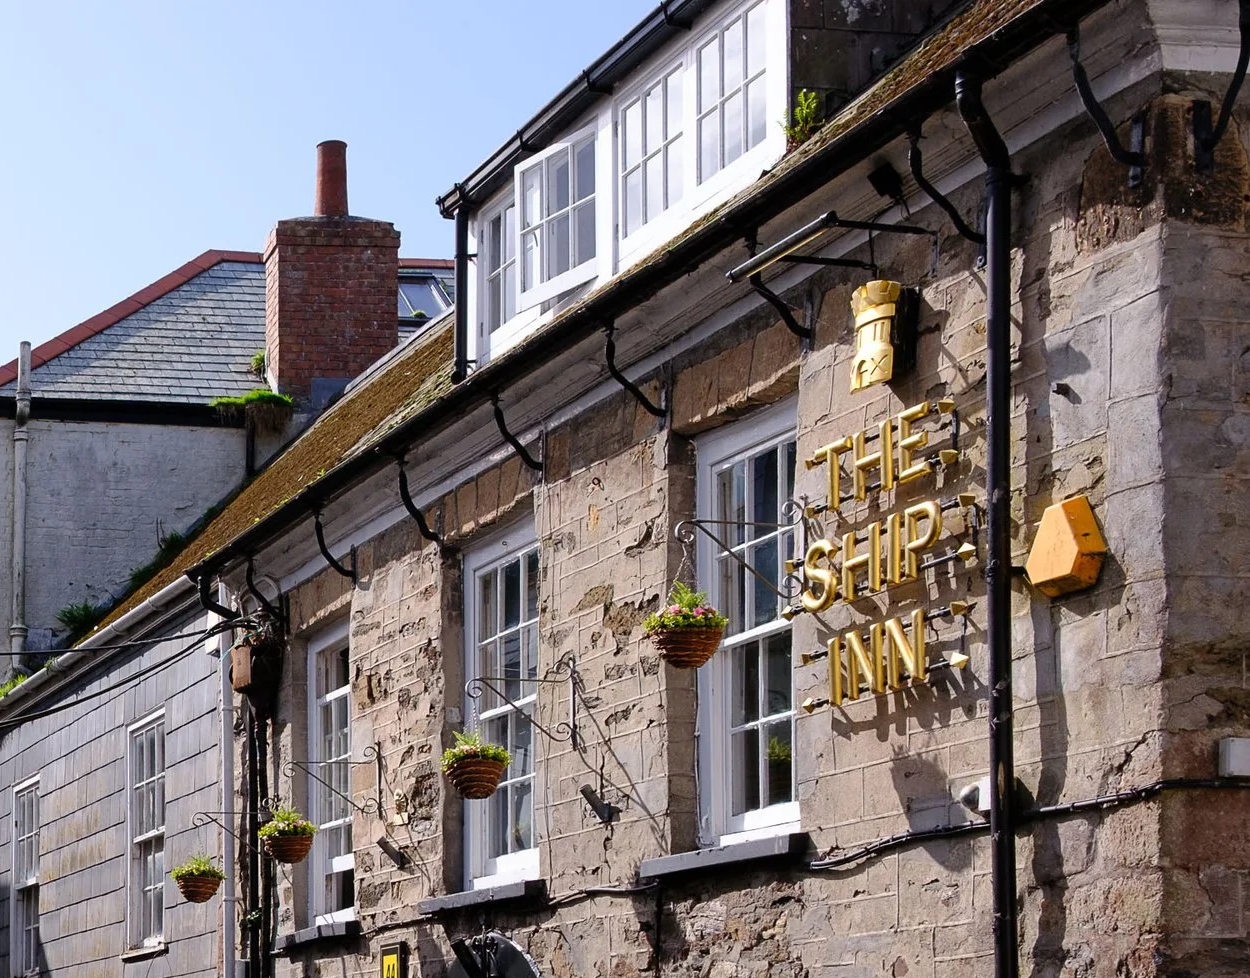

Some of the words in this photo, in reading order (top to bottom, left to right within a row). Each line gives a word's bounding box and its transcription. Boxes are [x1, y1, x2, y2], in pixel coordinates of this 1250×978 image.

[814, 400, 933, 513] THE
[800, 500, 943, 613] SHIP
[826, 607, 927, 708] INN
